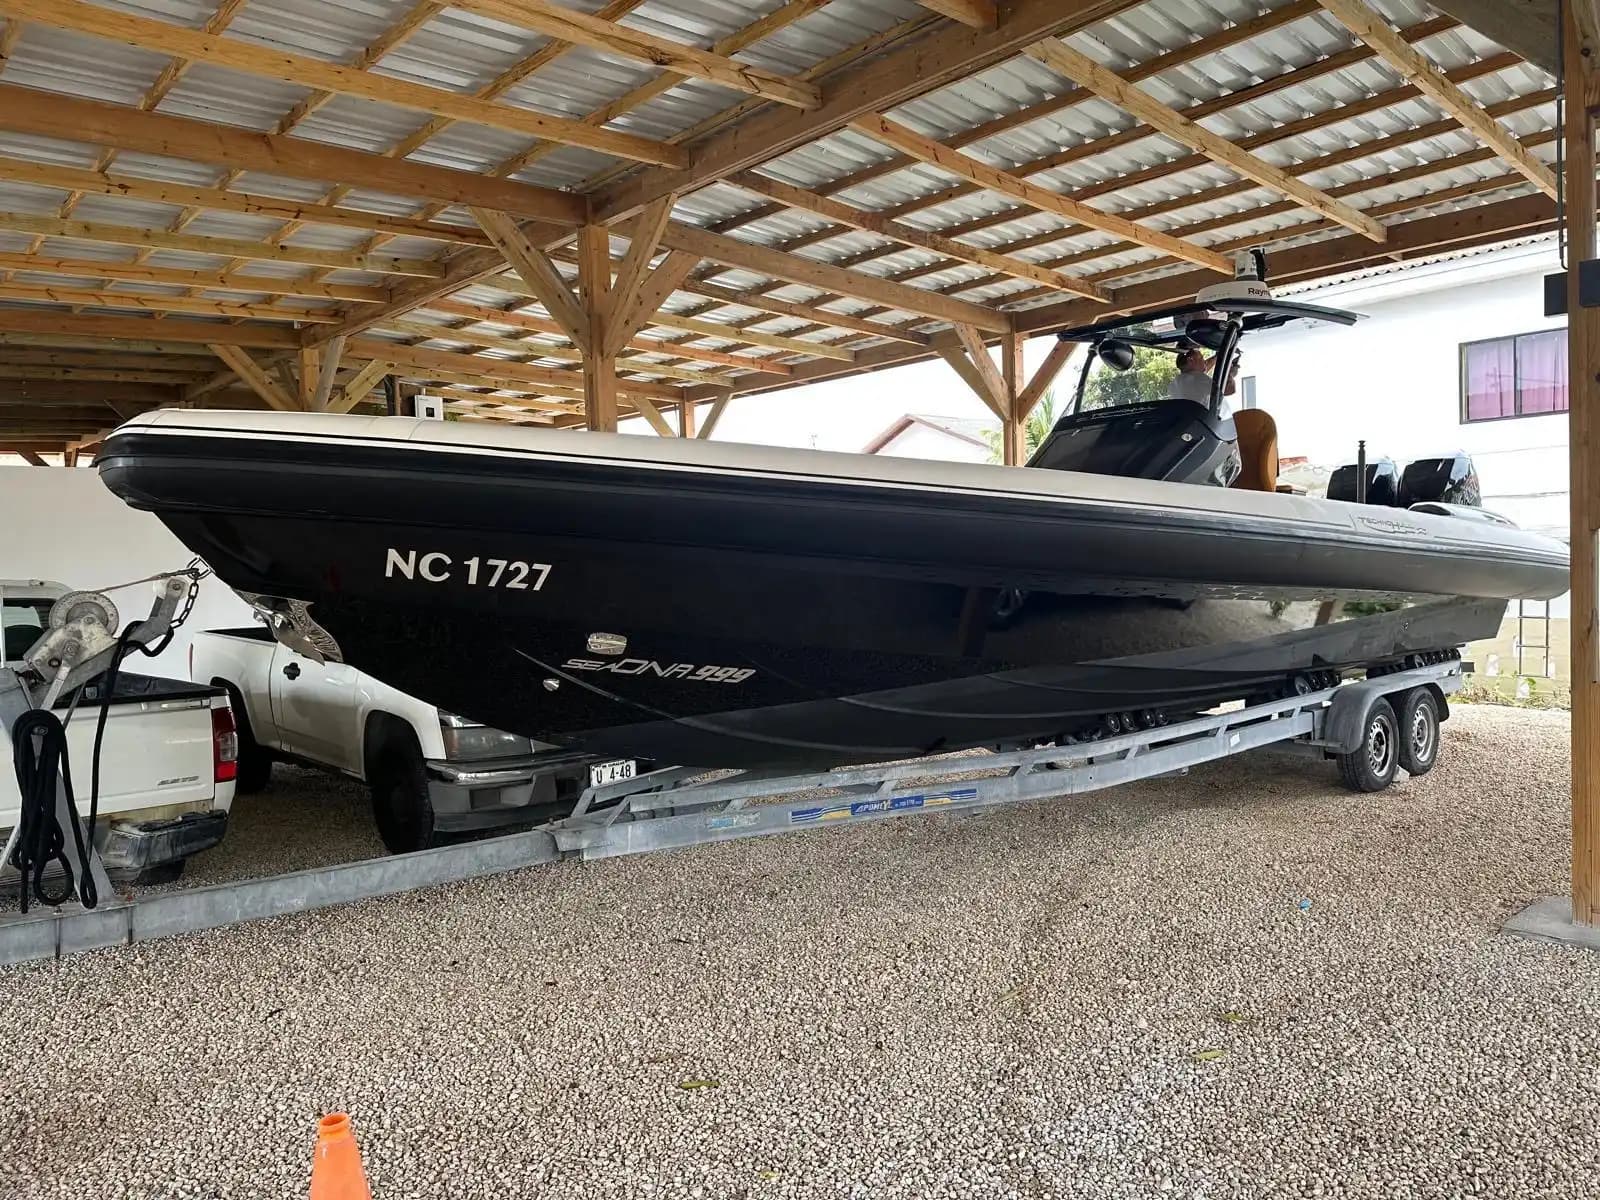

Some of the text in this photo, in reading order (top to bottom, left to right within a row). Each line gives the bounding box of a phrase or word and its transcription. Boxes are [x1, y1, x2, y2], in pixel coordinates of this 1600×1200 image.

[1247, 287, 1271, 297] Raym
[385, 548, 552, 591] NC 1727
[686, 665, 756, 683] 999
[596, 769, 603, 784] U
[610, 764, 631, 780] 4-48
